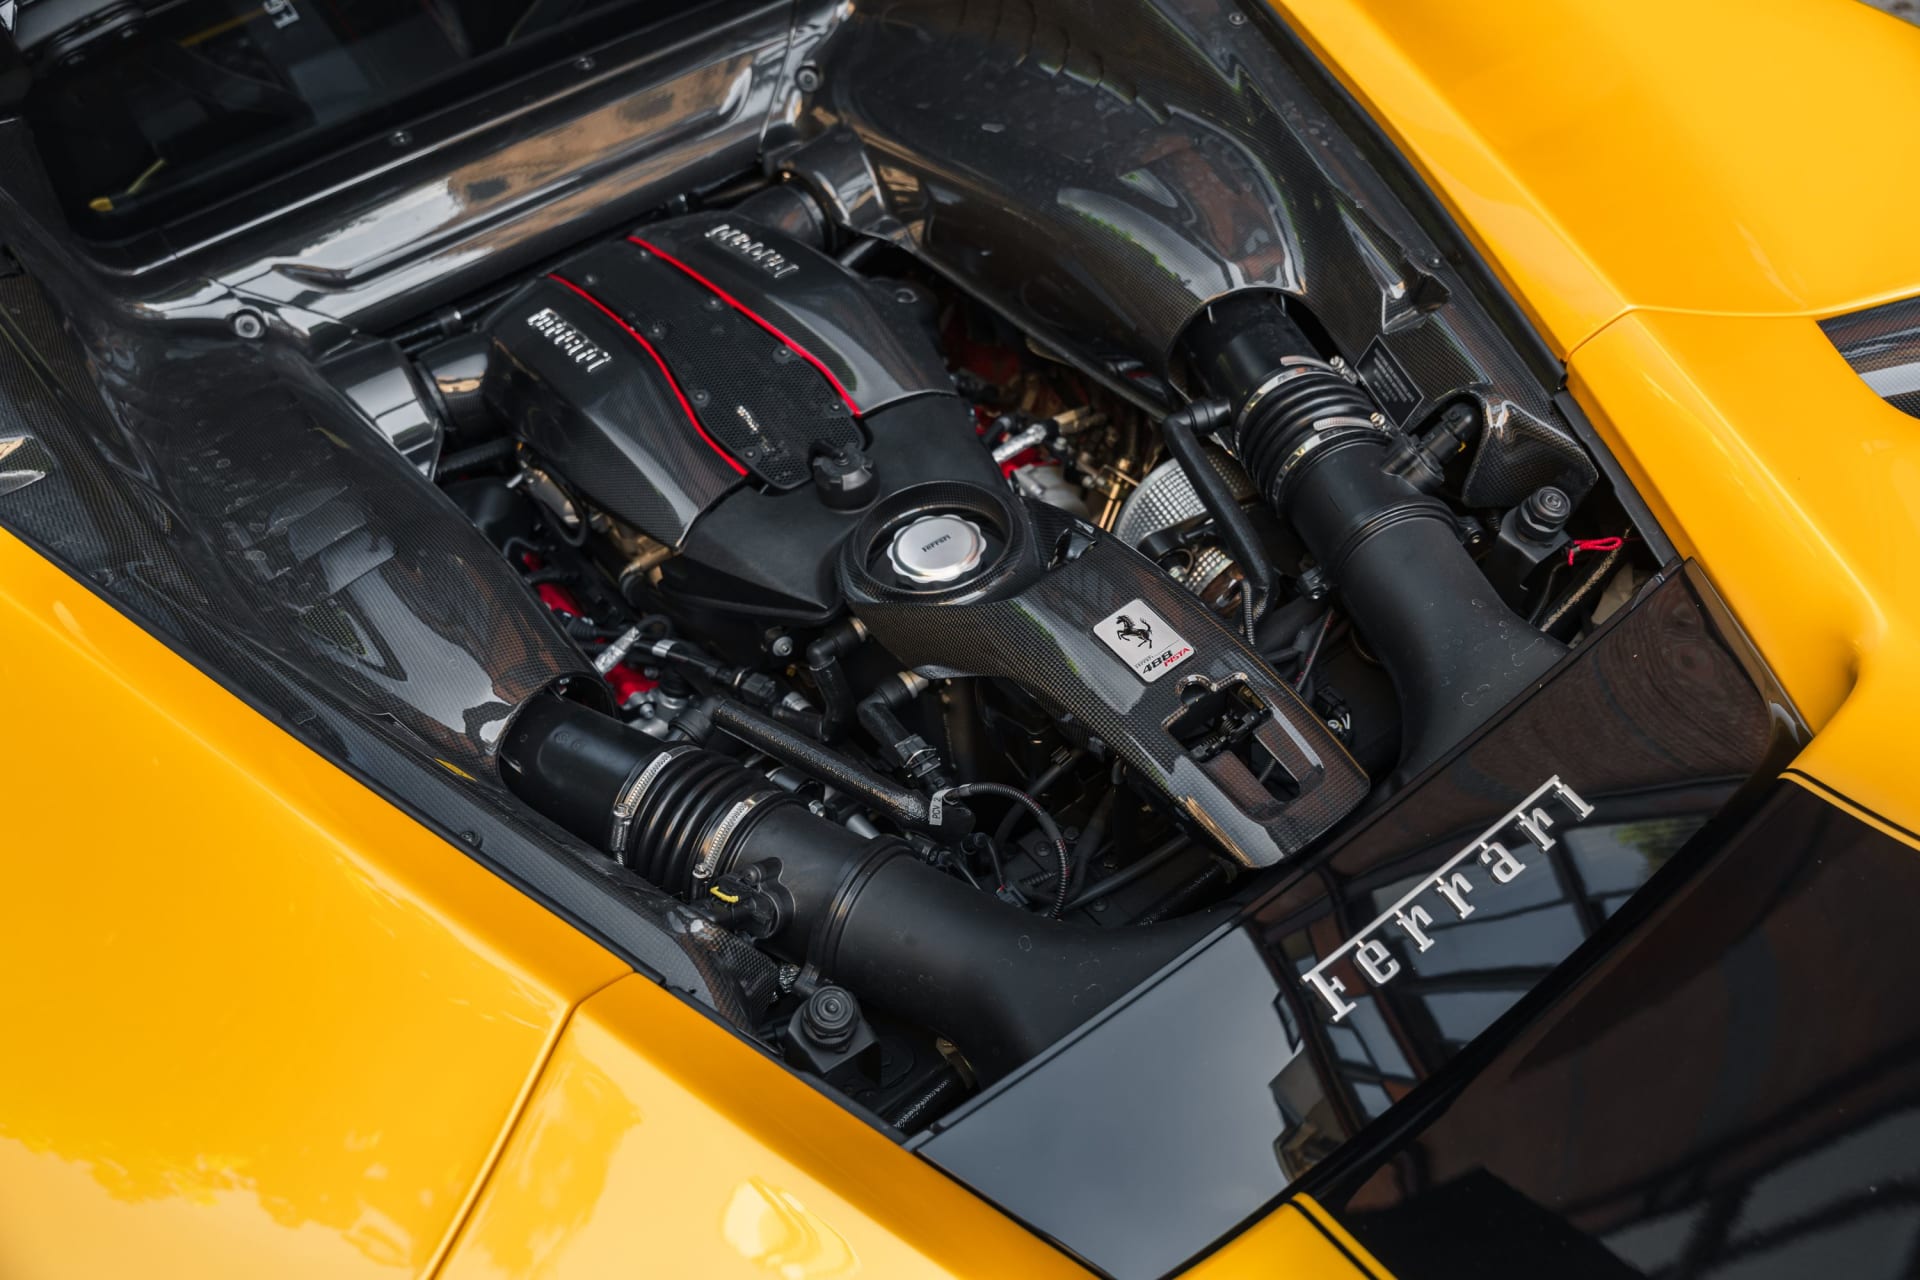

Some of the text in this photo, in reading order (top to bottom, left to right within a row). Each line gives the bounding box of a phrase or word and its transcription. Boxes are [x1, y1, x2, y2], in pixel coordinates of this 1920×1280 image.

[526, 307, 612, 374] Ferrari
[921, 533, 953, 553] Ferrari
[1142, 646, 1191, 674] 488 PISTA
[931, 804, 941, 819] PCV
[1302, 774, 1595, 1023] Ferrari
